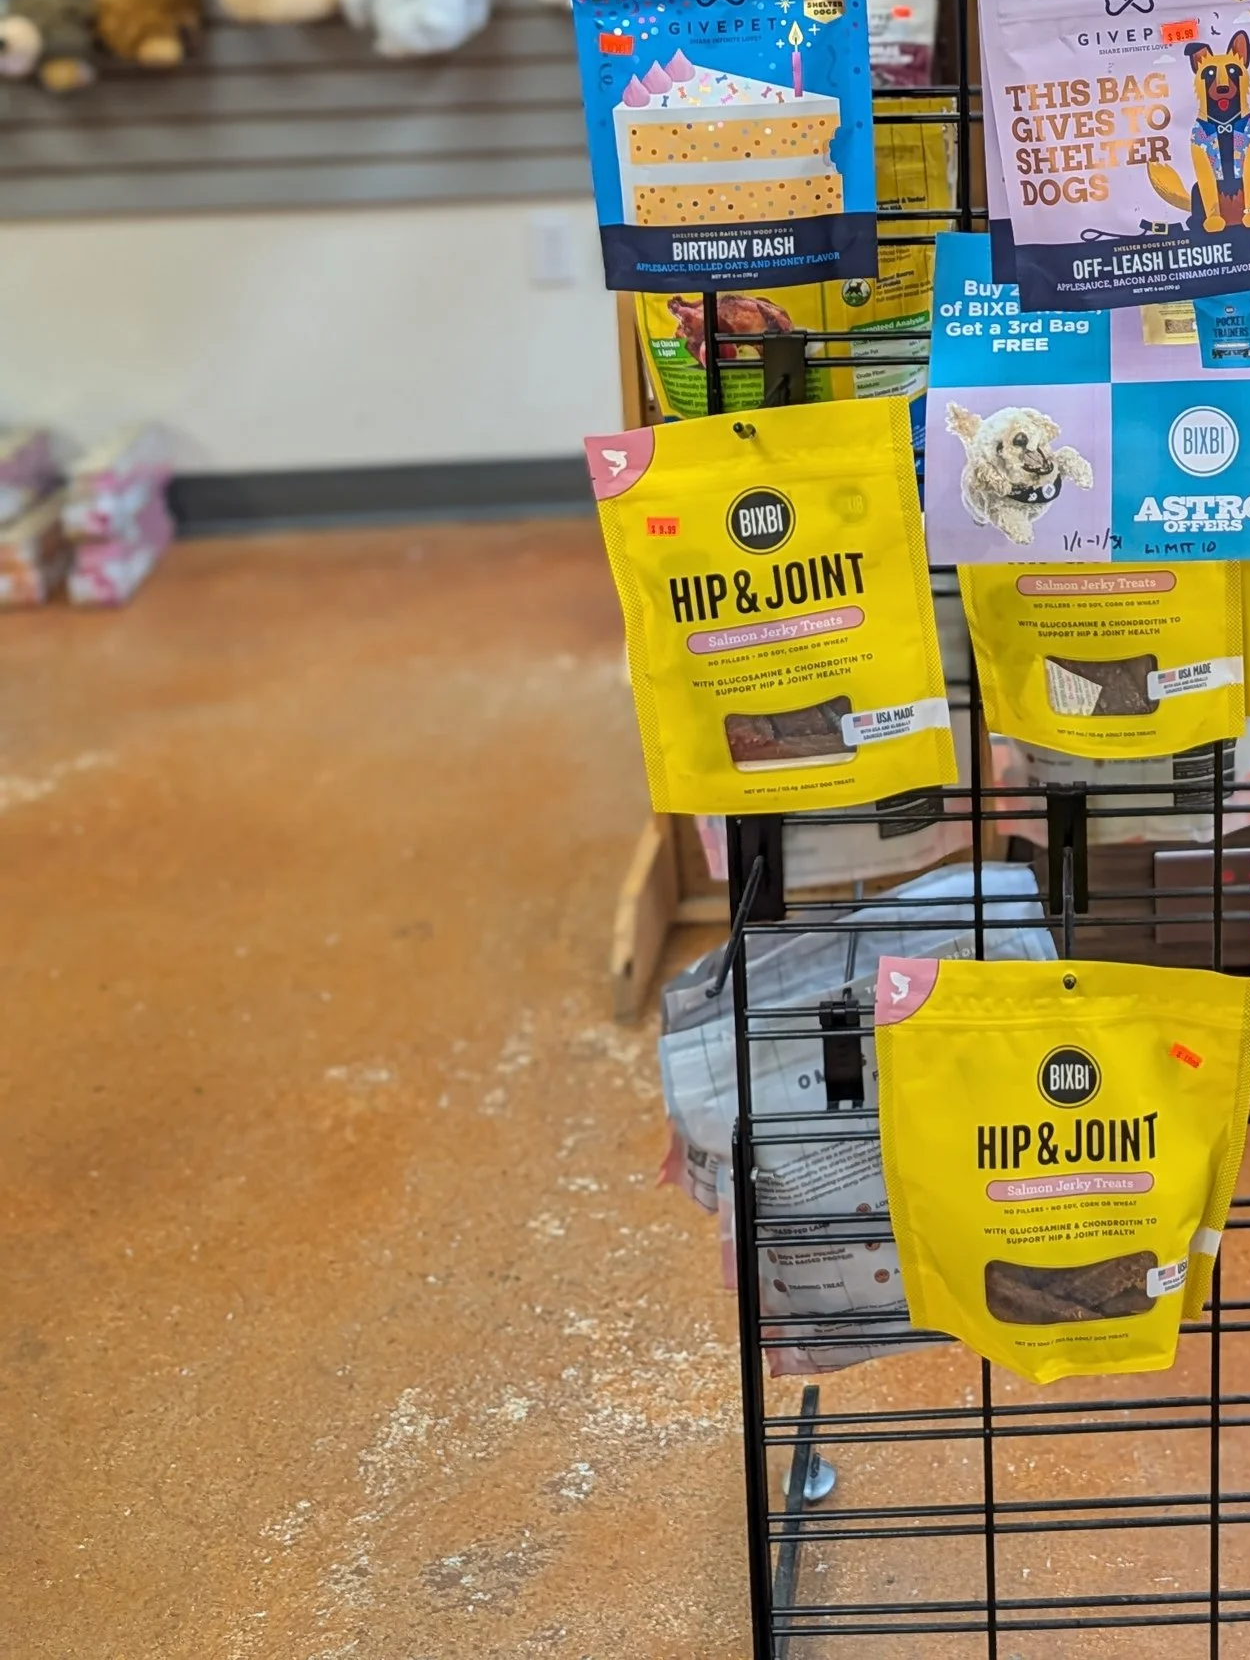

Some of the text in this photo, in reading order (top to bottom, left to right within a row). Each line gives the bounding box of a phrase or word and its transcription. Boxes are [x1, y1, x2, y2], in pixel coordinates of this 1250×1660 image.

[672, 236, 794, 261] BIRTHDAY BASH
[1073, 243, 1233, 279] OFF-LEASH LEISURE
[964, 280, 1003, 298] Buy
[941, 303, 965, 316] of
[946, 319, 1089, 336] Get a 3rd Bag
[1216, 316, 1246, 327] POCKET
[1213, 326, 1250, 337] TRAINERS
[993, 338, 1049, 353] FREE
[1183, 426, 1226, 455] BIXBI
[738, 505, 783, 537] BIXBI
[1164, 520, 1243, 532] OFFERS
[670, 553, 864, 623] HIP & JOINT
[708, 615, 843, 648] Salmon Jerky Treats
[877, 706, 914, 723] USA MADE
